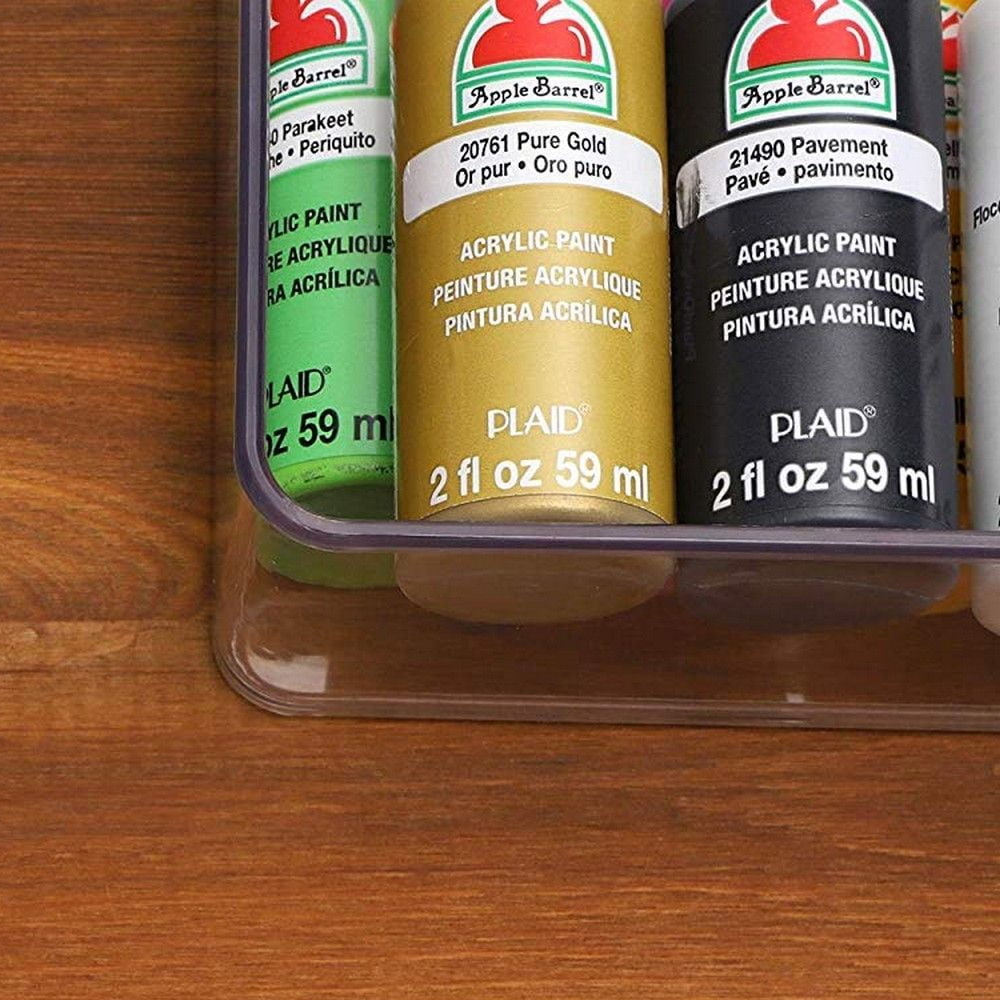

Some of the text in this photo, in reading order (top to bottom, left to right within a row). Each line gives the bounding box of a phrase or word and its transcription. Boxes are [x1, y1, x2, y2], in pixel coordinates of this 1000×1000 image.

[468, 83, 529, 108] Apple
[741, 82, 803, 109] Apple
[282, 110, 354, 140] Parakeet
[300, 131, 375, 157] Periquito
[460, 132, 607, 163] 20761 Pure Gold
[728, 137, 888, 171] 21490 Pavement
[455, 155, 612, 188] Or pur Oro puro
[725, 159, 894, 195] Pavé pavimento
[304, 203, 362, 228] PAINT
[973, 200, 1000, 230] Floc
[287, 235, 393, 266] ACRYLIQUE
[460, 230, 615, 262] ACRYLIC PAINT
[737, 232, 897, 266] ACRYLIC PAINT
[290, 267, 380, 298] ACRÍLICA
[433, 266, 642, 307] PEINTURE ACRYLIQUE
[710, 269, 809, 311] PEINTURE
[814, 267, 926, 301] ACRYLIQUE
[444, 300, 633, 337] PINTURA ACRÍLICA
[723, 304, 816, 342] PINTURA
[821, 301, 916, 333] ACRÍLICA
[298, 408, 340, 447] 59
[353, 405, 394, 442] ml
[429, 450, 649, 506] 2 fl oz 59 ml
[712, 452, 936, 512] 2 fl oz 59 ml
